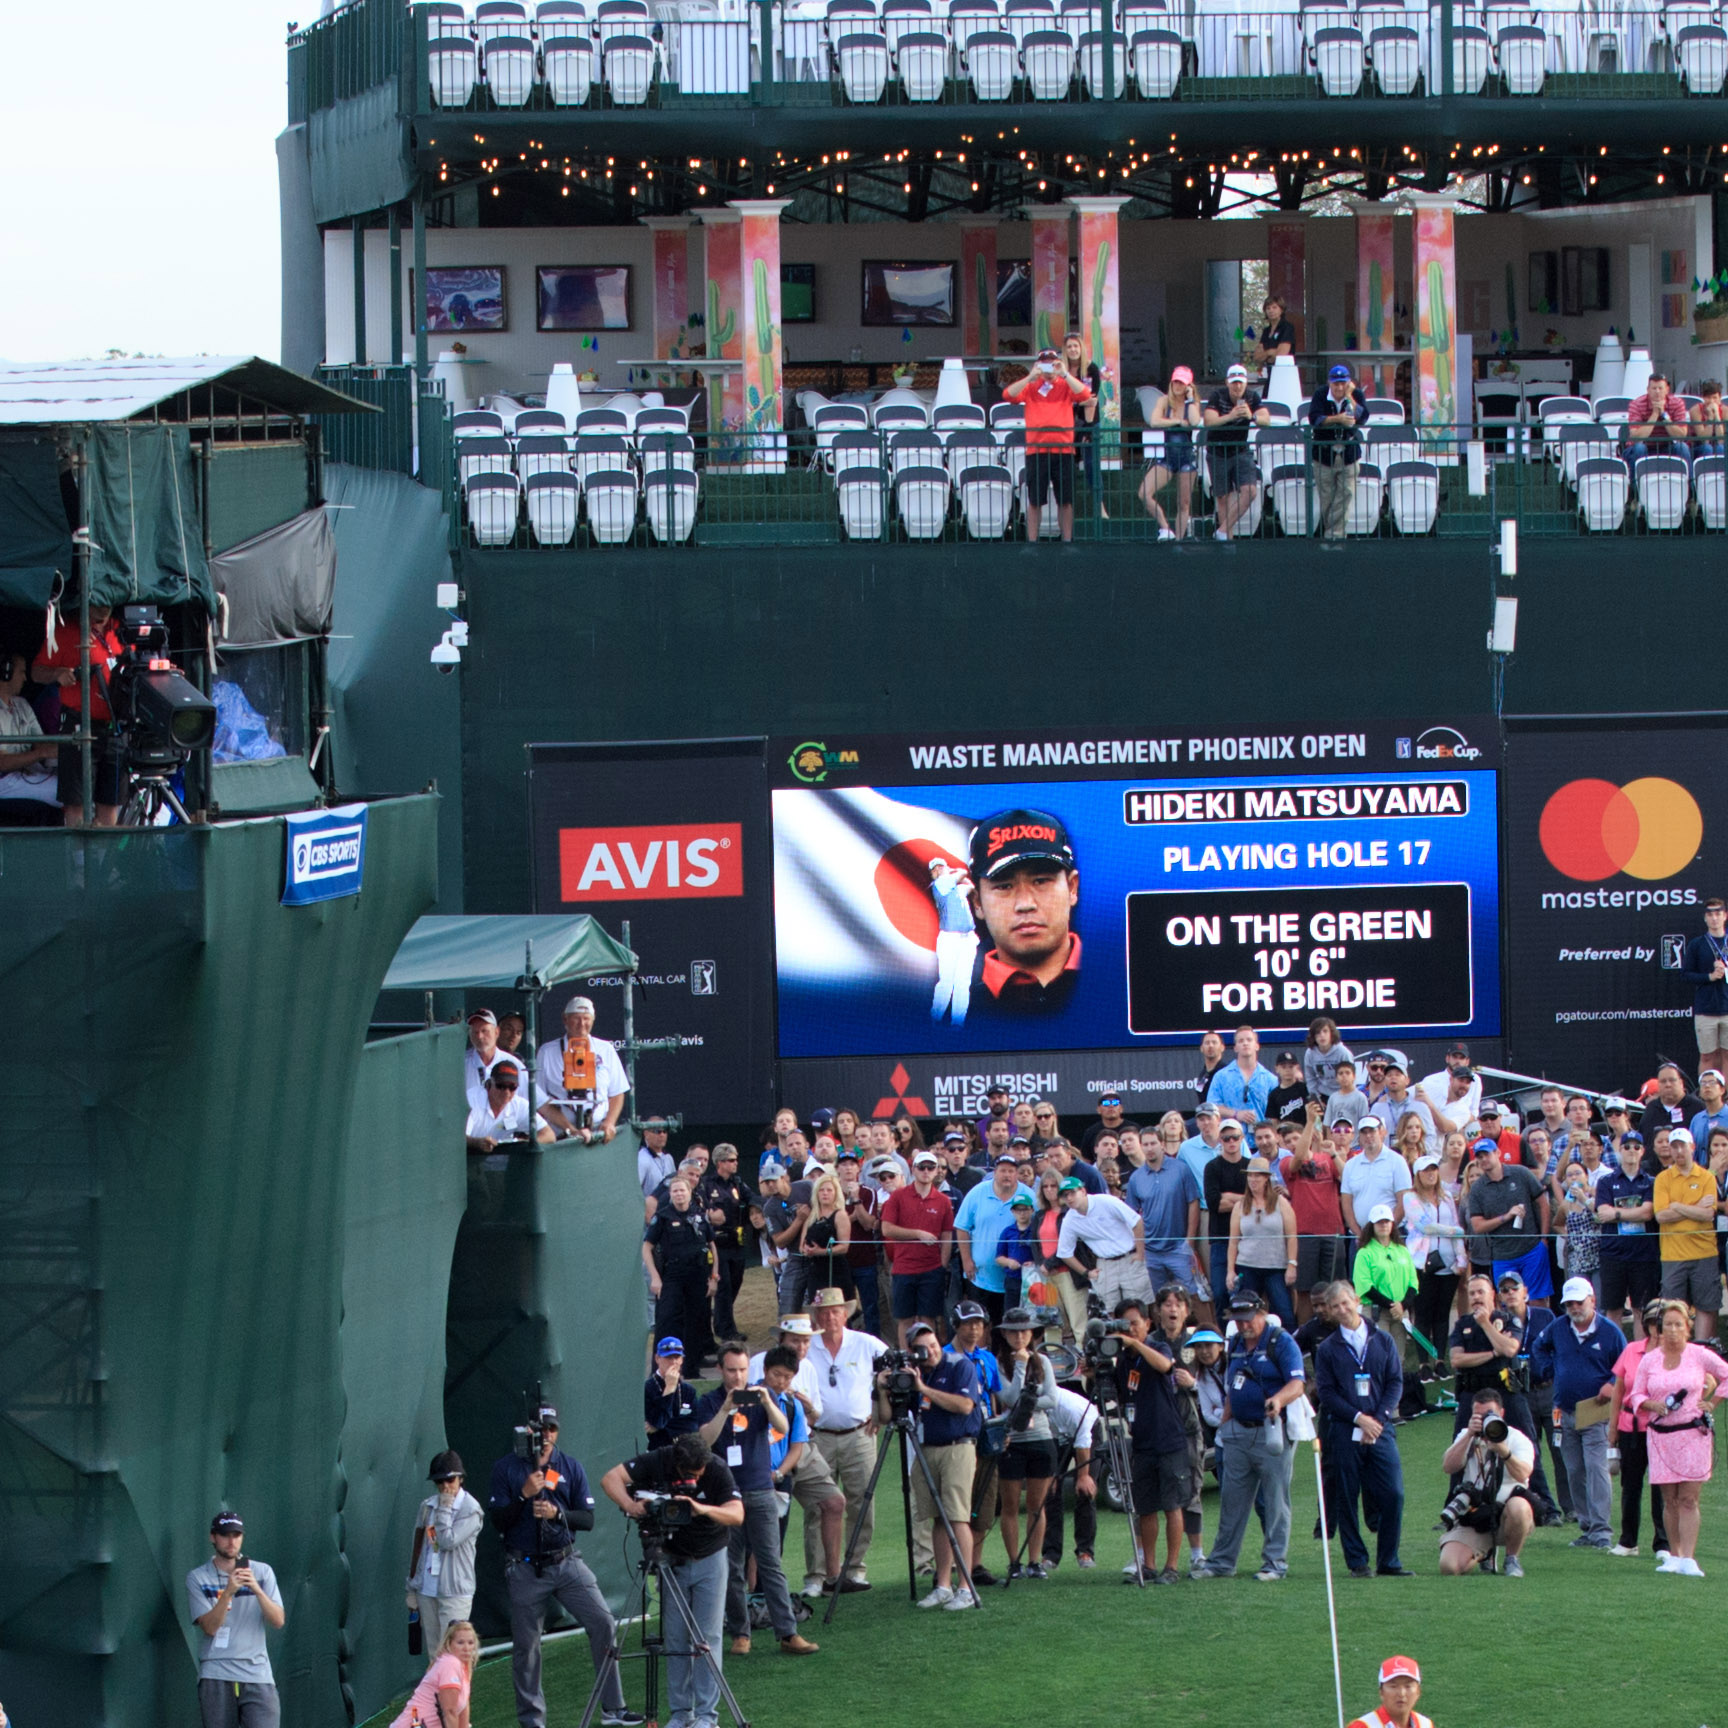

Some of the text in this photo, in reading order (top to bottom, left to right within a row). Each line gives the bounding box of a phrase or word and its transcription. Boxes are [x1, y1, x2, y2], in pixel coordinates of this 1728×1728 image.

[823, 751, 860, 763] WM
[909, 734, 1366, 770] WASTE MANAGEMENT PHOENIX OPEN
[1416, 744, 1479, 761] FedExCup
[1130, 786, 1461, 821] HIDEKI MATSUYAMA
[311, 840, 358, 867] CBS SPORTS
[987, 824, 1057, 857] SRIXON
[576, 838, 720, 890] AVIS
[1163, 841, 1431, 873] PLAYING HOLE 17
[1541, 888, 1698, 911] masterpass
[1166, 910, 1432, 946] ON THE GREEN
[1254, 947, 1346, 978] 10' 6"
[1558, 946, 1631, 962] Preferred
[1635, 946, 1655, 963] by
[588, 977, 625, 987] OFFICIA
[666, 974, 686, 984] CAR
[1203, 978, 1396, 1013] FOR BIRDIE
[1555, 1006, 1693, 1023] pgatour.com/mastercard
[1087, 1079, 1128, 1093] Official
[1130, 1079, 1185, 1094] Sponsors
